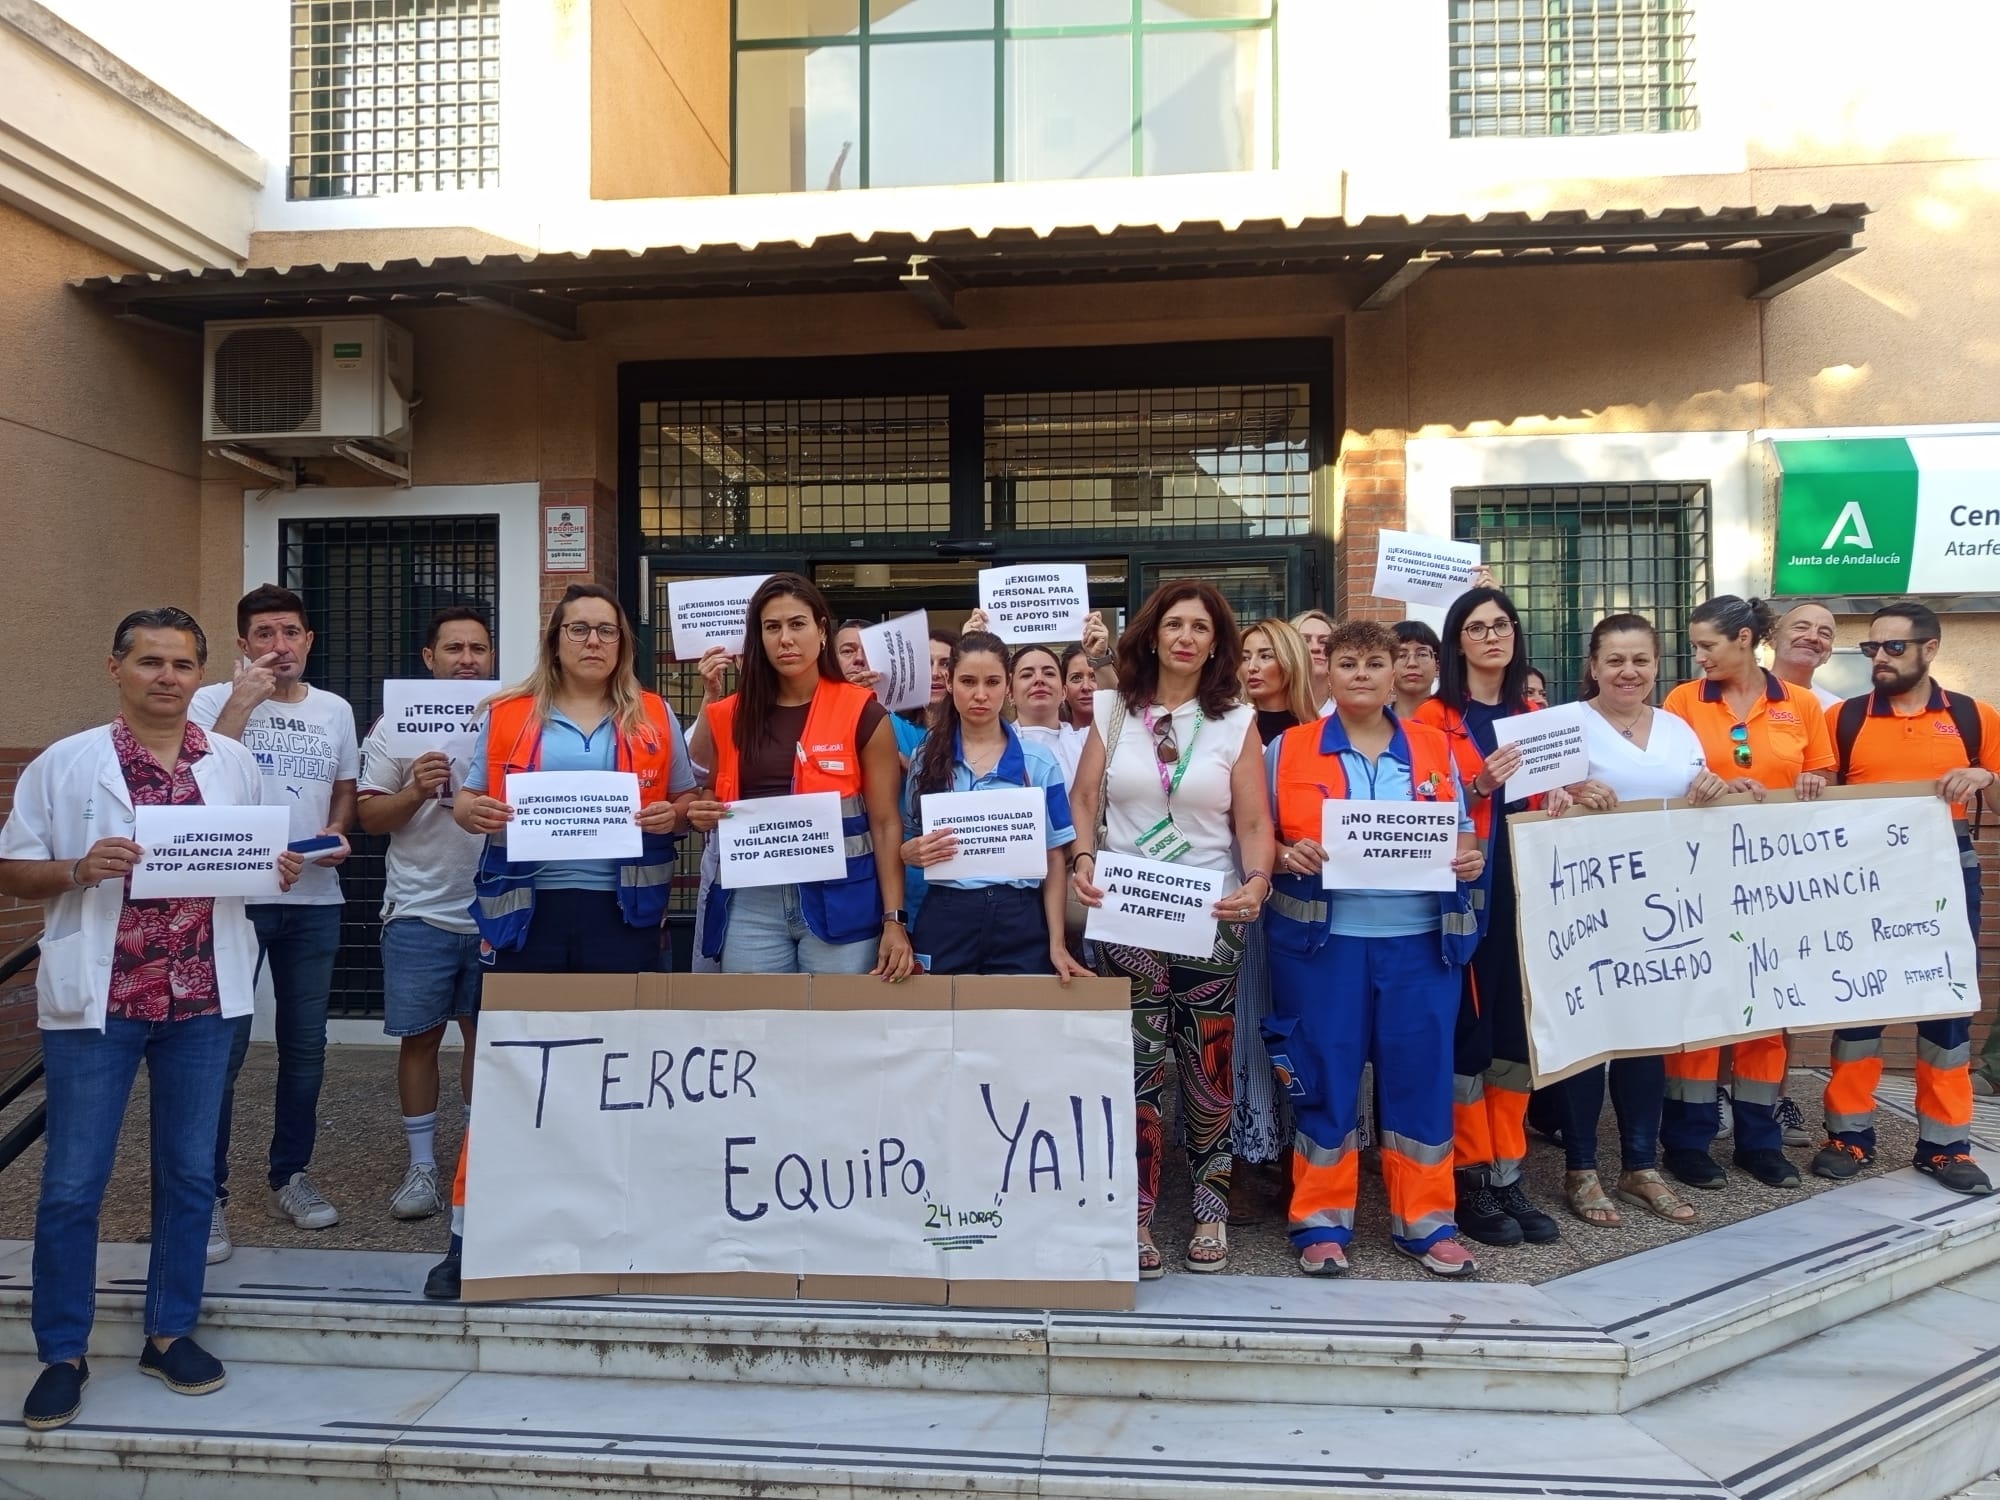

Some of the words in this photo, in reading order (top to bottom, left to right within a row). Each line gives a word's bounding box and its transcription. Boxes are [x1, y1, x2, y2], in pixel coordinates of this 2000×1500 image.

[1945, 539, 2000, 556] Atarfe
[1397, 556, 1450, 570] CONDICIONES
[1434, 552, 1472, 565] IGUALDAD
[1788, 555, 1822, 566] Junta
[1825, 554, 1839, 564] de
[1842, 552, 1901, 565] Andalucía
[1005, 574, 1060, 585] ¡¡EXIGIMOS
[1387, 564, 1403, 572] RTU
[1404, 568, 1447, 579] NOCTURNA
[1448, 574, 1468, 583] PARA
[992, 588, 1045, 597] PERSONAL
[1048, 586, 1074, 594] PARA
[1010, 598, 1080, 608] DISPOSITIVOS
[690, 608, 746, 618] CONDICIONES
[1016, 612, 1049, 620] APOYO
[1052, 610, 1069, 618] SIN
[682, 622, 697, 630] RTU
[700, 619, 746, 628] NOCTURNA
[1013, 624, 1057, 633] CUBRIR!!
[405, 704, 475, 717] ¡¡TERCER
[269, 717, 306, 732] 1948
[397, 722, 455, 733] EQUIPO
[1548, 726, 1580, 739] IGUALDAD
[1520, 740, 1563, 756] ONDICIONES
[1564, 736, 1582, 746] SUAP,
[1525, 752, 1562, 766] NOCTURNA
[1564, 747, 1581, 756] PARA
[519, 795, 577, 805] ¡¡¡EXIGIMOS
[533, 806, 602, 815] CONDICIONES
[604, 806, 631, 814] SUAP,
[988, 811, 1033, 821] IGUALDAD
[545, 818, 600, 826] NOCTURNA
[603, 817, 628, 825] PARA
[1342, 813, 1372, 825] ¡¡NO
[1376, 814, 1455, 825] RECORTES
[551, 829, 597, 837] ATARFE!!!
[749, 820, 813, 834] ¡¡¡EXIGIMOS
[952, 824, 1008, 834] ONDICIONES
[1011, 823, 1036, 831] SUAP,
[173, 833, 253, 845] ¡¡¡EXIGIMOS
[734, 835, 799, 847] VIGILANCIA
[802, 832, 829, 842] 24H!!
[958, 836, 1007, 845] NOCTURNA
[1348, 831, 1358, 840] A
[1362, 831, 1448, 842] URGENCIAS
[153, 848, 233, 857] VIGILANCIA
[237, 847, 270, 857] 24H!!
[730, 851, 760, 861] STOP
[764, 845, 834, 858] AGRESIONES
[963, 847, 1005, 856] ATARFE!!!
[1363, 848, 1432, 859] ATARFE!!!
[146, 862, 183, 871] STOP
[187, 862, 273, 871] AGRESIONES
[1550, 844, 1647, 906] ATARFE
[1732, 822, 1849, 867] ALBOLOTE
[1886, 824, 1910, 847] SE
[1104, 866, 1133, 878] ¡¡NO
[1137, 870, 1212, 892] RECORTES
[1108, 884, 1117, 893] A
[1122, 885, 1203, 908] URGENCIAS
[1120, 903, 1186, 922] ATARFE!!!
[1548, 908, 1609, 961] QUEDAN
[1798, 939, 1811, 960] A
[1824, 929, 1854, 952] LOS
[1871, 917, 1941, 943] RECORTES
[1565, 986, 1585, 1016] DE
[1588, 950, 1712, 996] TRASLADO
[1774, 983, 1806, 1010] DEL
[1832, 969, 1888, 1002] SUAP
[490, 1038, 757, 1128] TERCER
[980, 1083, 1114, 1208] YA!!
